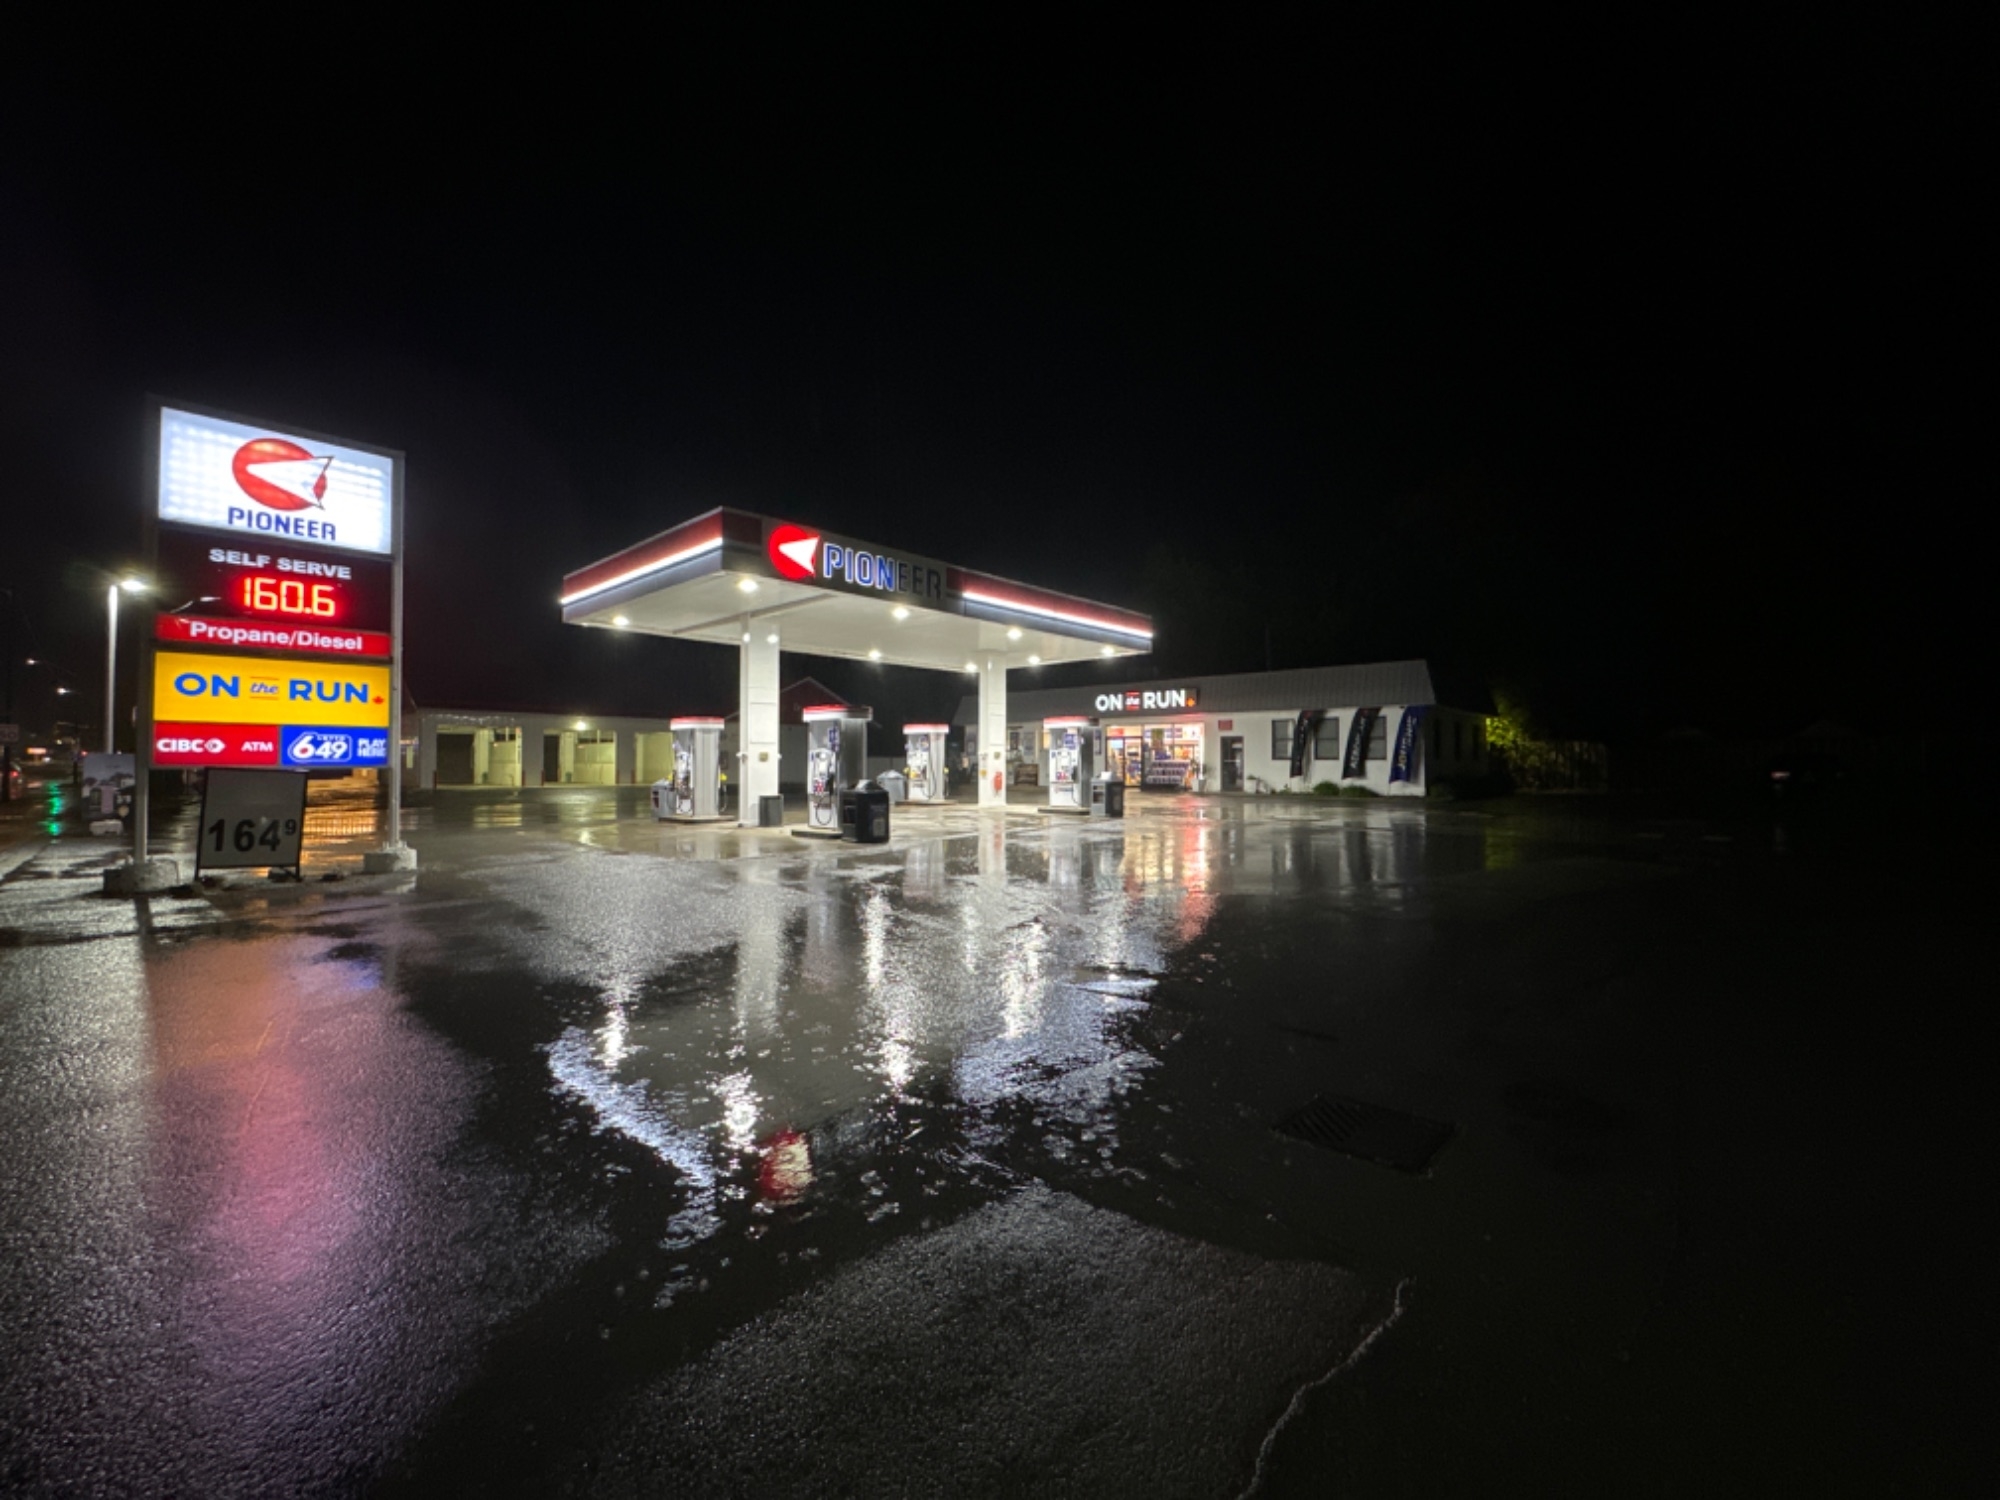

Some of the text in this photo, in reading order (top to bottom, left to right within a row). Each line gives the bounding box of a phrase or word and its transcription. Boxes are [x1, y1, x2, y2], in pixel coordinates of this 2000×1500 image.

[228, 506, 336, 541] PIONEER
[209, 548, 352, 580] SELF SERVE
[823, 541, 942, 600] PIONEER
[243, 576, 336, 617] 160.6
[189, 621, 363, 651] Propane/Diesel
[174, 672, 369, 704] ON the RUN
[1095, 692, 1123, 711] ON
[1143, 688, 1186, 709] RUN
[156, 738, 273, 753] CIBC ATM
